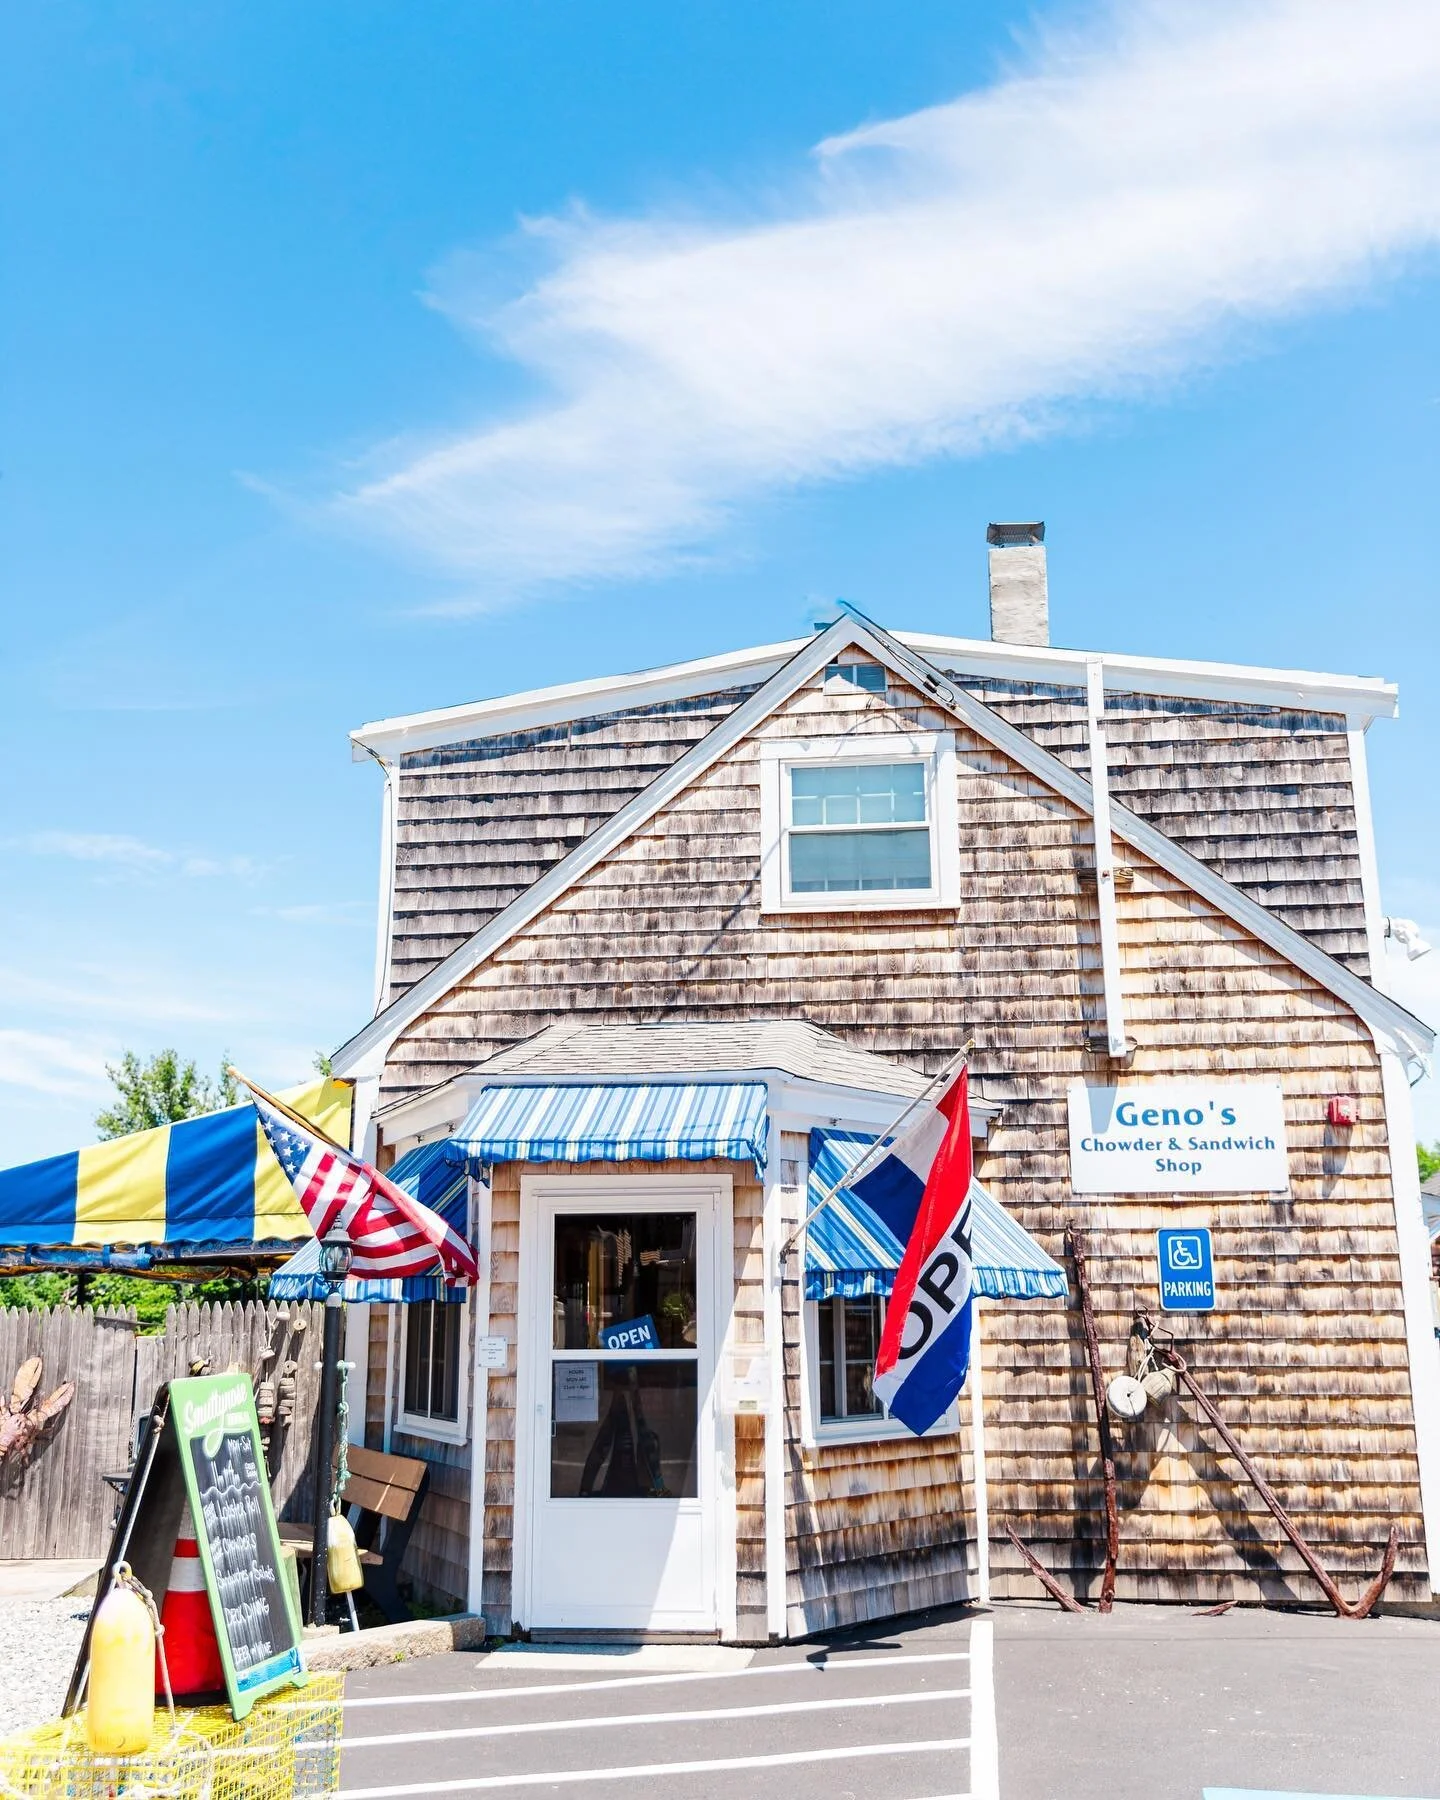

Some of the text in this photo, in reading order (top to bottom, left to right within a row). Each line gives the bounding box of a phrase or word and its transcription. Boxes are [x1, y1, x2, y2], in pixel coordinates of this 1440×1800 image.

[1116, 1101, 1237, 1127] Geno's
[1080, 1136, 1275, 1152] Chowder & Sandwich
[1155, 1158, 1202, 1175] Shop
[1163, 1281, 1211, 1297] PARKING
[607, 1325, 651, 1350] OPEN
